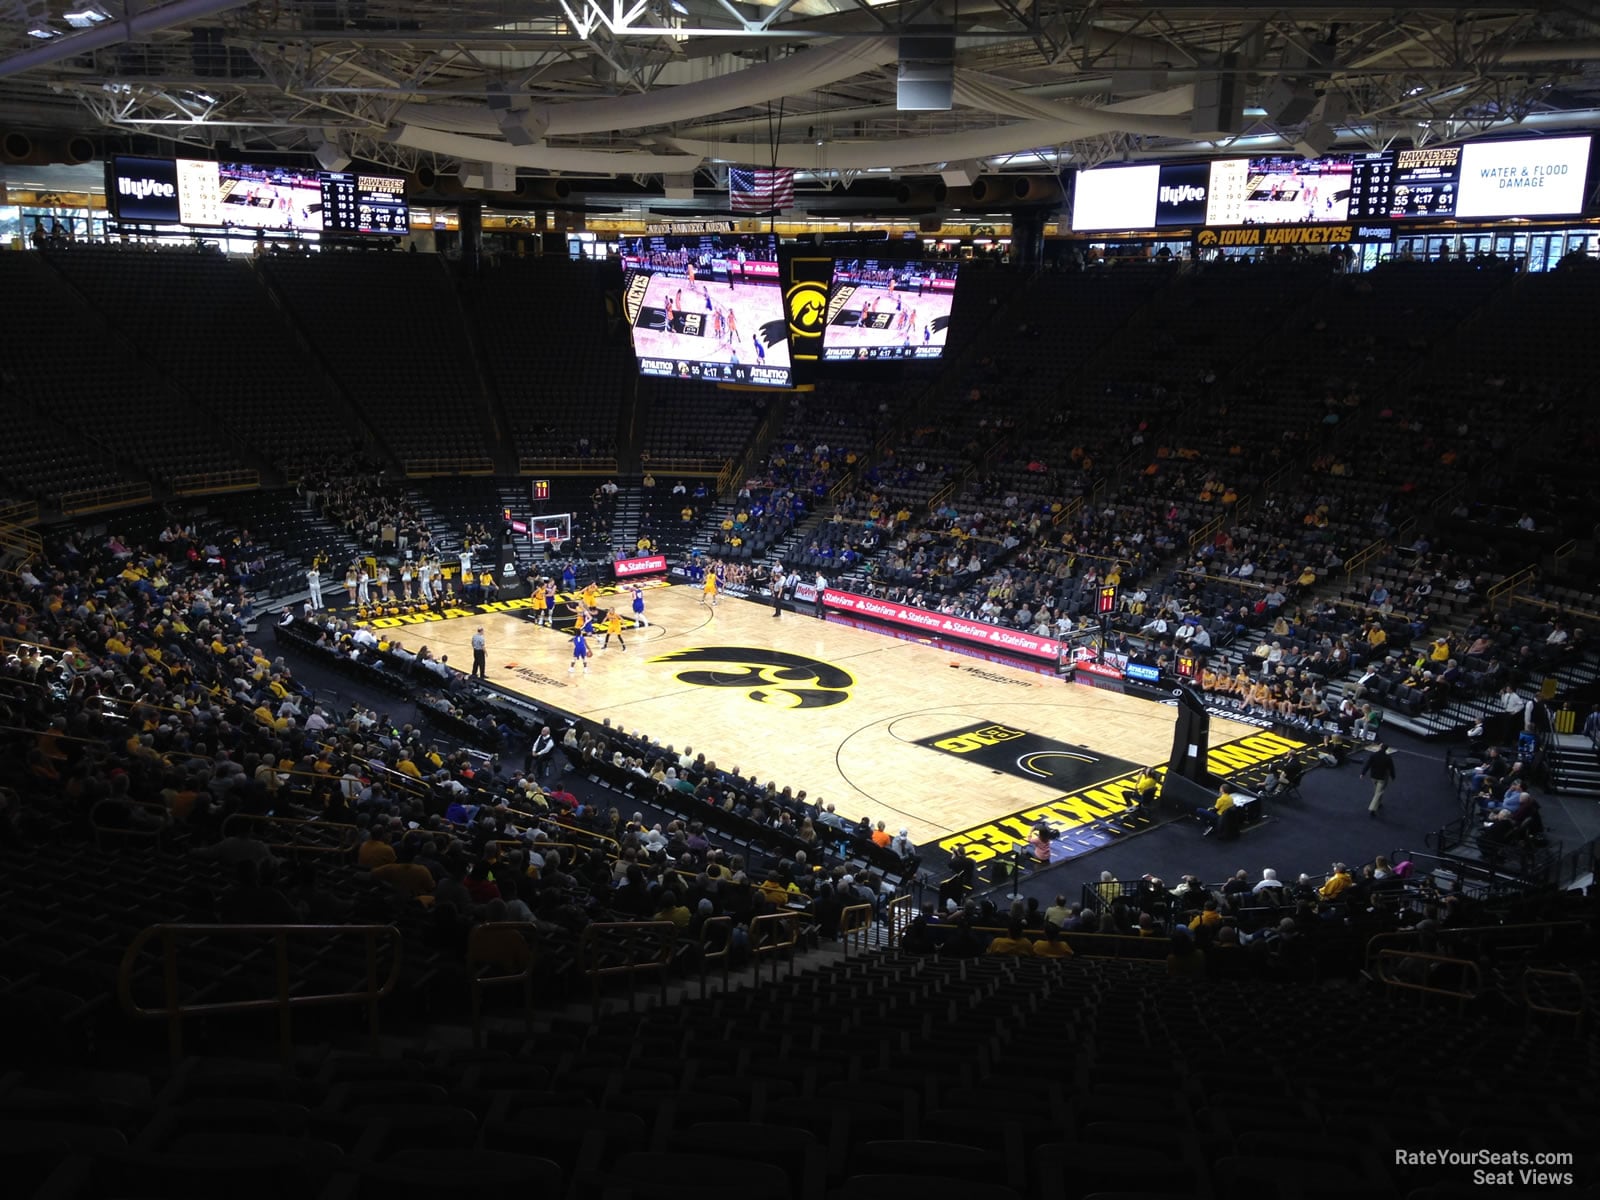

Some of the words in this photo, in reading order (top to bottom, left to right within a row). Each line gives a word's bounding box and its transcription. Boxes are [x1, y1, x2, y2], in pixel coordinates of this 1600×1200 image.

[1400, 148, 1460, 161] HAWKEYES
[1481, 167, 1516, 178] WATER
[1522, 167, 1528, 176] &
[1534, 165, 1568, 175] FLOOD
[358, 176, 404, 188] HAWKEYES
[1499, 177, 1545, 188] DAMAGE
[1394, 196, 1408, 205] 55
[1413, 194, 1433, 203] 4:17
[1439, 194, 1453, 204] 61
[360, 214, 372, 222] 55
[1219, 230, 1259, 245] IOWA
[1264, 227, 1353, 244] HAWKEYES
[1359, 227, 1391, 238] Mycogen
[641, 359, 673, 370] ATHLETICO
[704, 368, 718, 377] 4:17
[736, 370, 745, 378] 61
[750, 367, 788, 379] ATHLETICO
[538, 487, 546, 497] 11
[1102, 596, 1113, 610] 11
